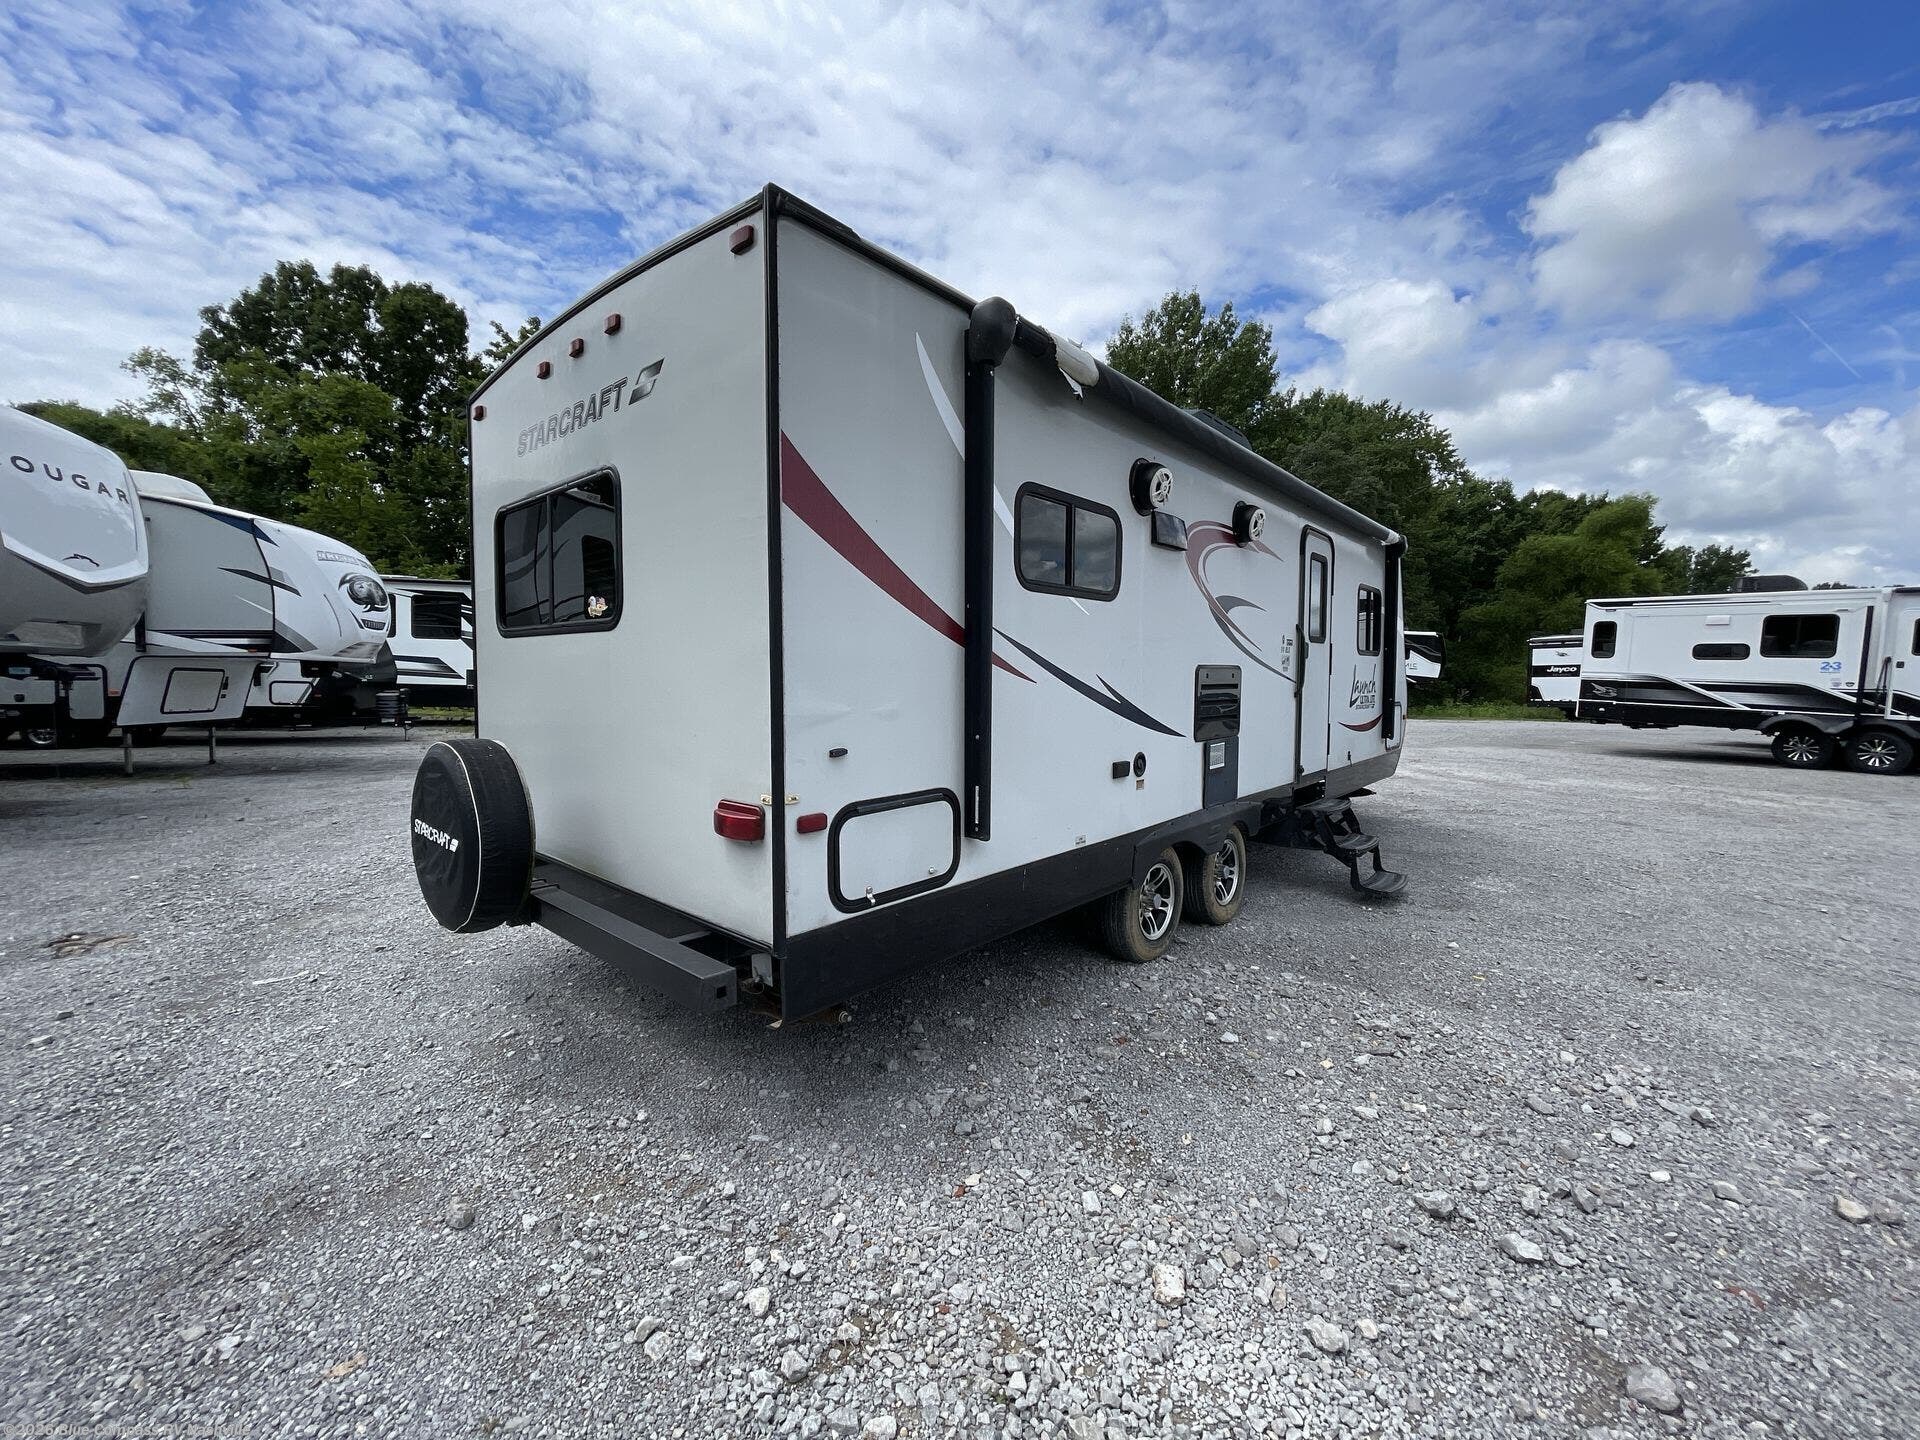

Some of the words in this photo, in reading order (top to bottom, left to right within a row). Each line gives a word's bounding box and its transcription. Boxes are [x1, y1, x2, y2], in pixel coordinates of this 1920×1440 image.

[517, 376, 628, 457] STARCRAFT
[0, 455, 130, 504] OUGAR
[1349, 663, 1377, 708] Launch
[1546, 665, 1577, 673] Jayco
[414, 818, 451, 850] STARCRAFT
